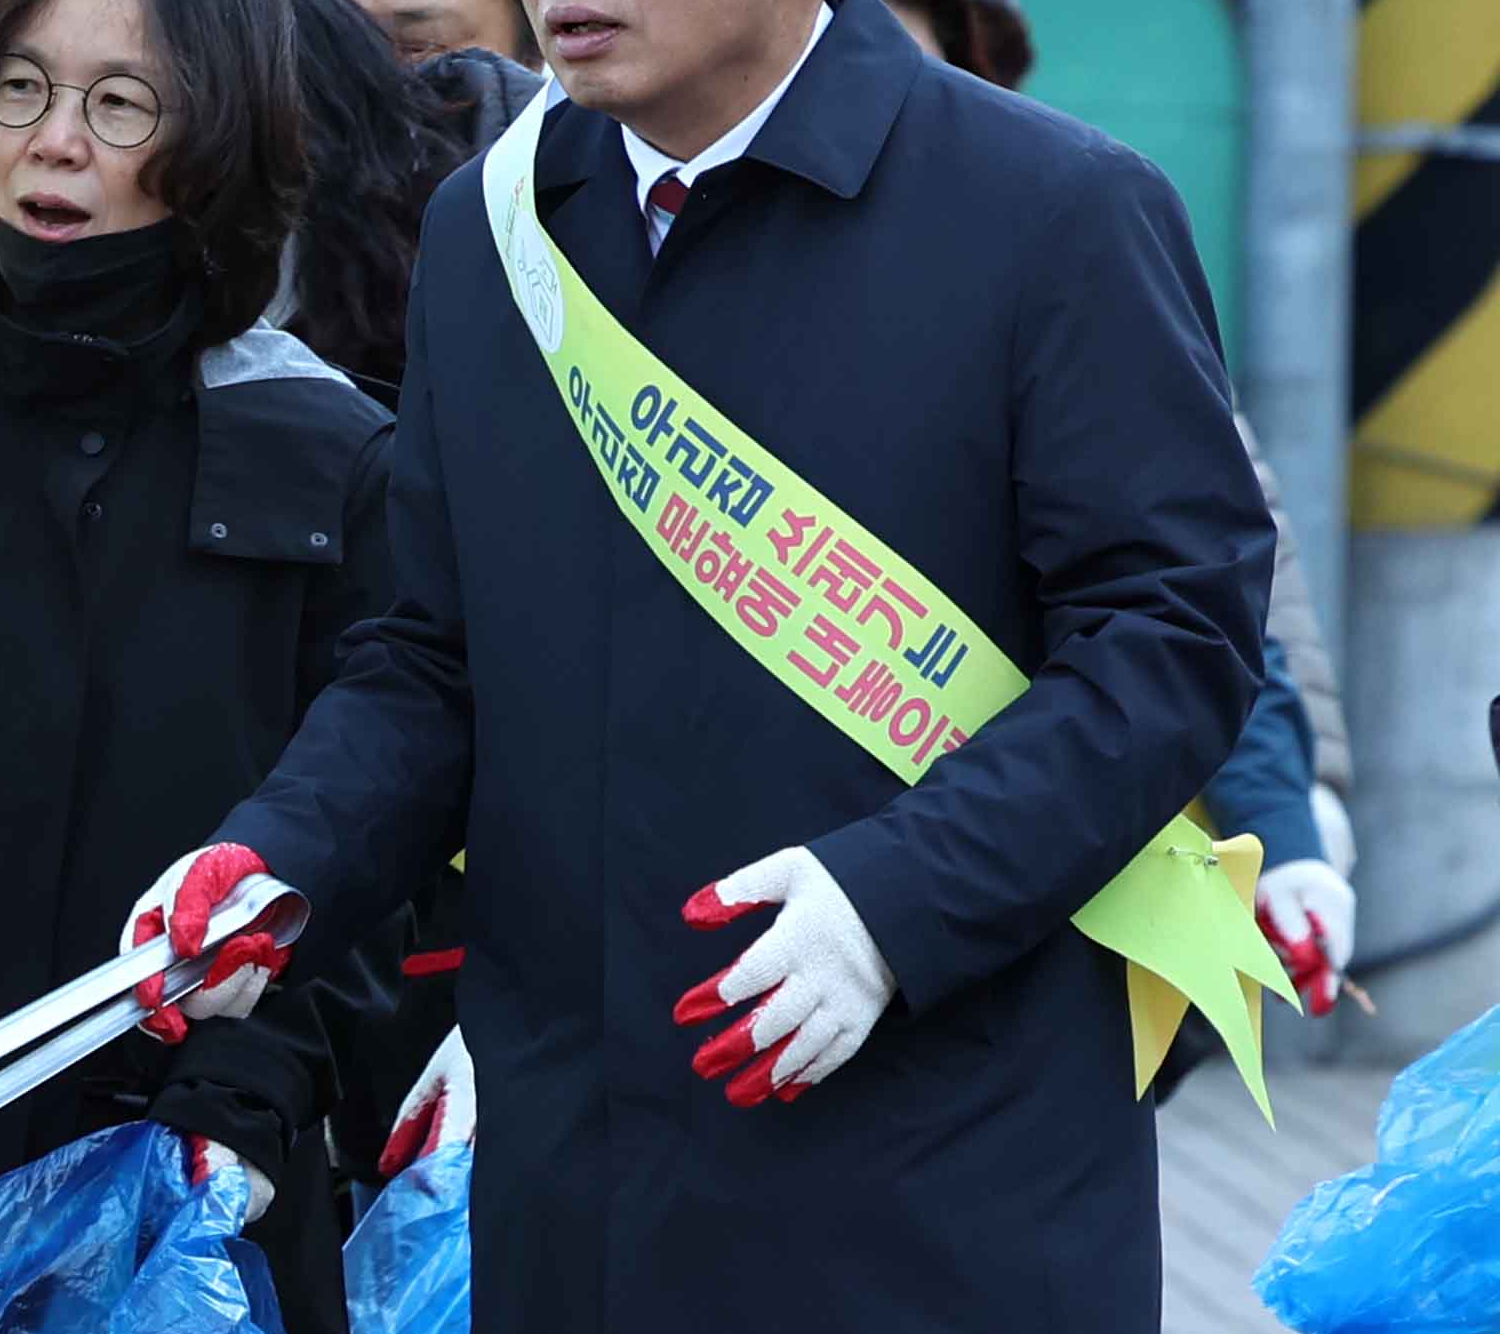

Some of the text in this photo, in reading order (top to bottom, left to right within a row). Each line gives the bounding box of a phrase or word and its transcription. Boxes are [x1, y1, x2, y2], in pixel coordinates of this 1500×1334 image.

[567, 365, 662, 515] 우리집
[655, 492, 801, 639] 문앞에
[630, 383, 969, 689] 우리집 쓰레기는
